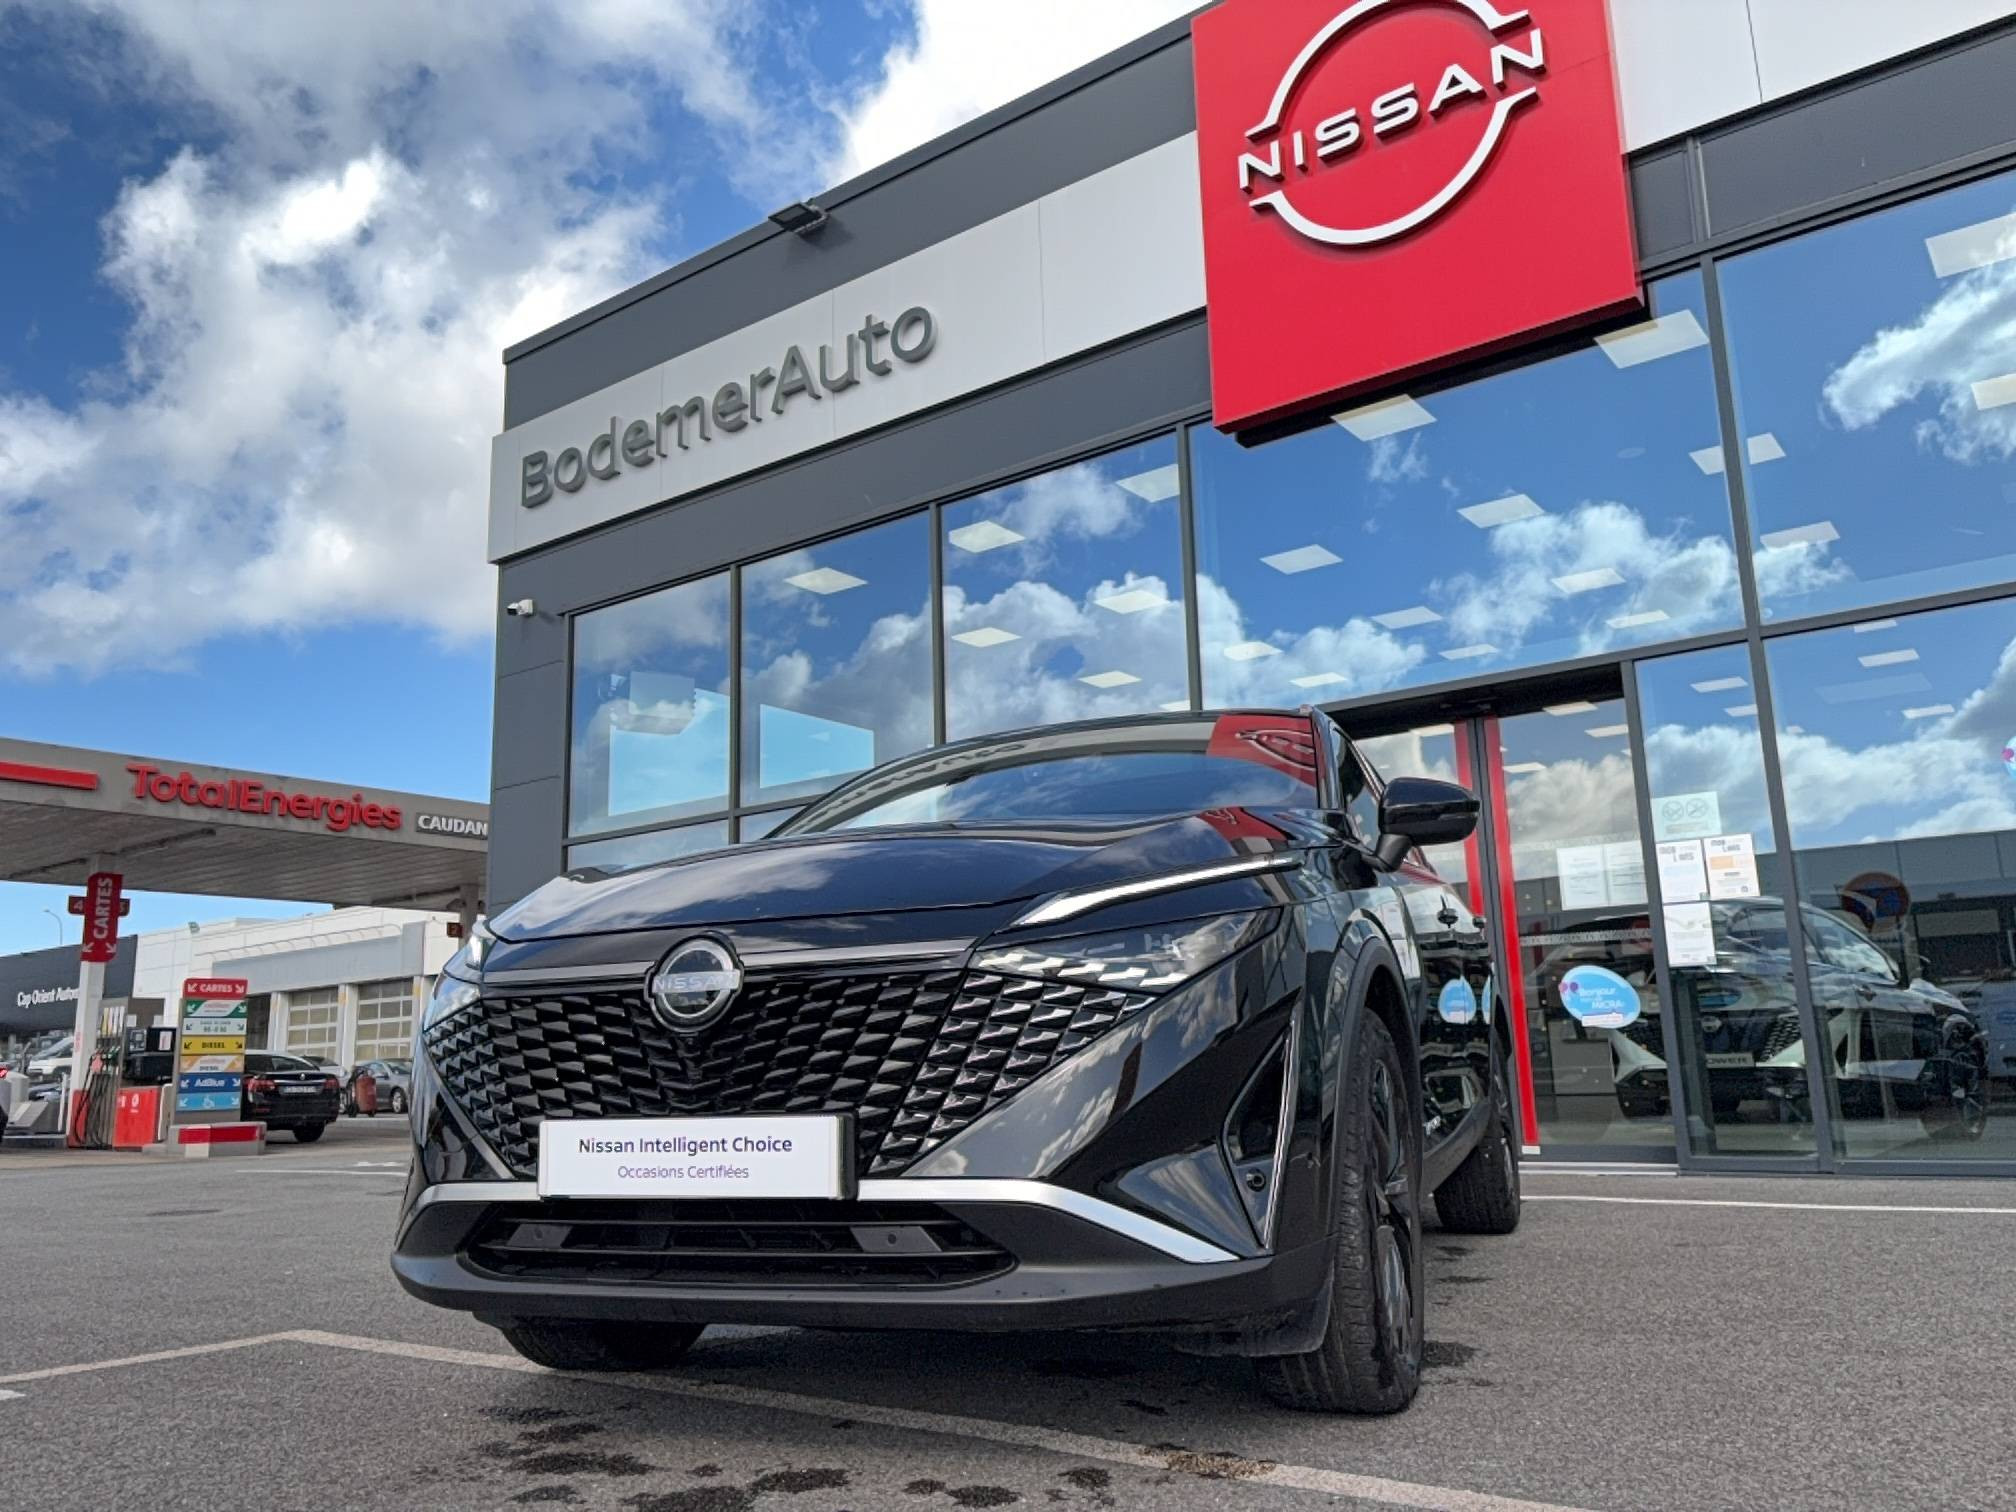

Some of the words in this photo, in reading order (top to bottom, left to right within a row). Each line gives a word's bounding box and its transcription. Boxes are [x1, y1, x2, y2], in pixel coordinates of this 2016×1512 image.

[1237, 27, 1547, 193] NISSAN
[521, 306, 938, 509] BodemerAuto
[126, 762, 402, 833] TotalEnergies
[418, 815, 488, 836] CAUDAN
[93, 877, 113, 939] CARTES
[652, 973, 738, 992] NISSA
[578, 1137, 635, 1154] Nissan
[639, 1136, 728, 1157] Intelligent
[732, 1136, 793, 1152] Choice
[617, 1165, 684, 1179] Occasions
[687, 1164, 750, 1179] Certifiées
